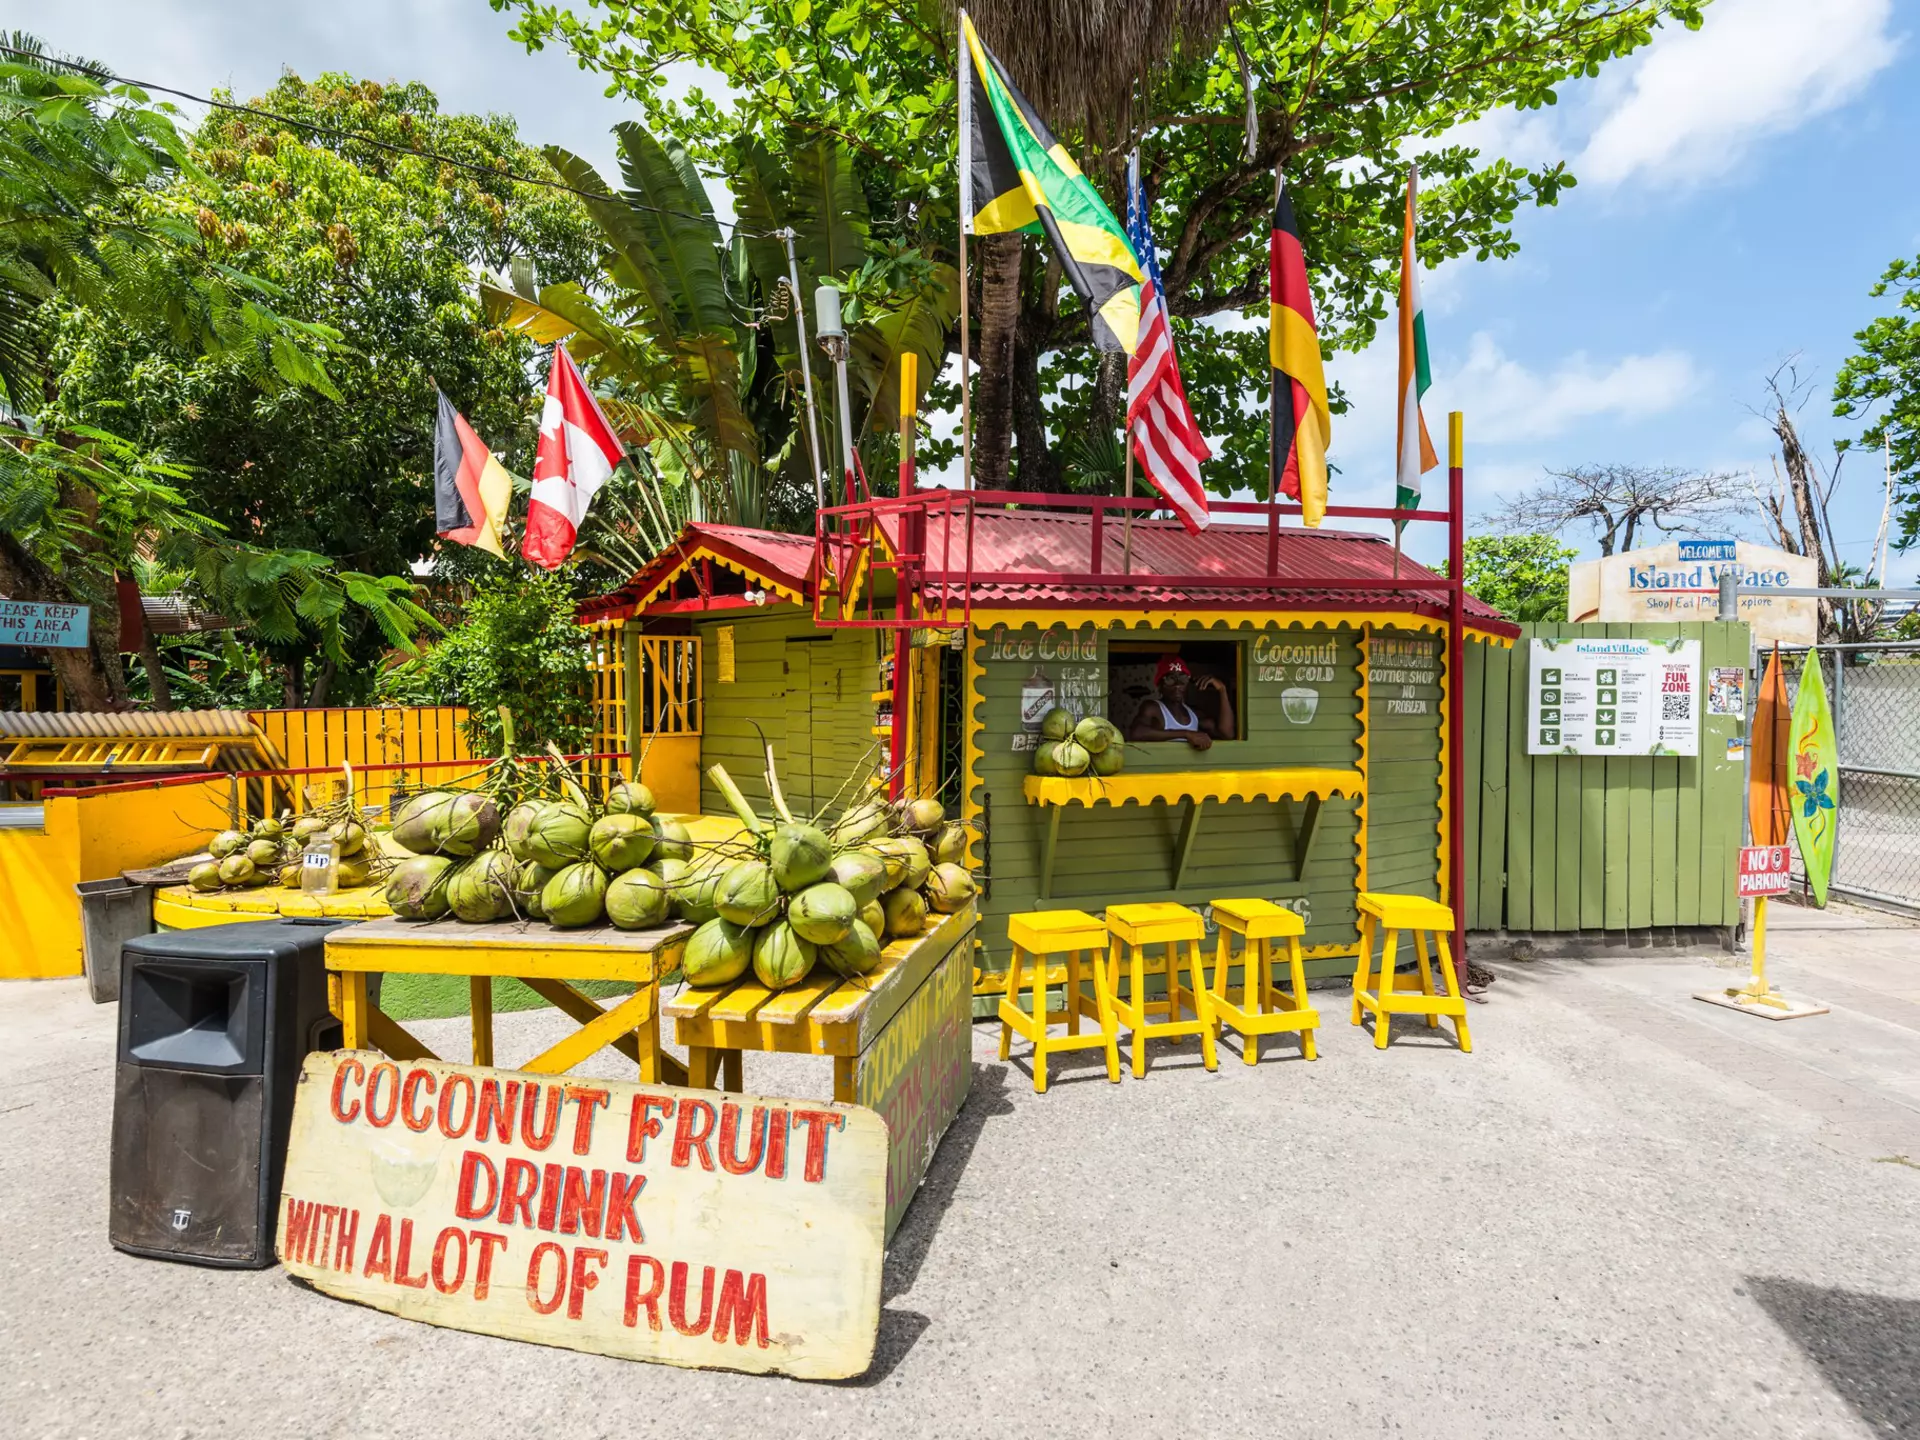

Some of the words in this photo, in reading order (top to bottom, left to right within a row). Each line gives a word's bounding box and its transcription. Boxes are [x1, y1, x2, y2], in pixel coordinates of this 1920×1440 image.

[1679, 545, 1721, 559] WELCOME
[1722, 545, 1736, 559] TO
[1628, 565, 1702, 589] Island
[1647, 597, 1669, 609] Shop
[1740, 597, 1773, 610] xplore
[45, 606, 79, 619] KEEP
[34, 619, 72, 632] AREA
[15, 631, 60, 644] CLEAN
[991, 628, 1034, 660] Ice
[1039, 629, 1097, 660] Cold
[1252, 634, 1340, 665] Coconut
[1576, 644, 1610, 653] Island
[1611, 644, 1649, 655] Village
[1258, 666, 1285, 682] ICE
[1295, 666, 1335, 682] COLD
[1409, 671, 1434, 684] SHOP
[1665, 672, 1688, 682] FUN
[1402, 685, 1416, 699] NO
[1661, 682, 1691, 693] ZONE
[1387, 700, 1427, 714] PROBLEM
[305, 854, 328, 867] Tip
[1748, 850, 1769, 871] NO
[1741, 871, 1789, 892] PARKING
[862, 983, 931, 1109] COCONUT
[329, 1058, 610, 1156] COCONUT
[626, 1093, 846, 1184] FRUIT
[455, 1150, 648, 1244] DRINK
[285, 1197, 360, 1274] WITH
[526, 1241, 609, 1321] OF
[623, 1255, 770, 1350] RUM
